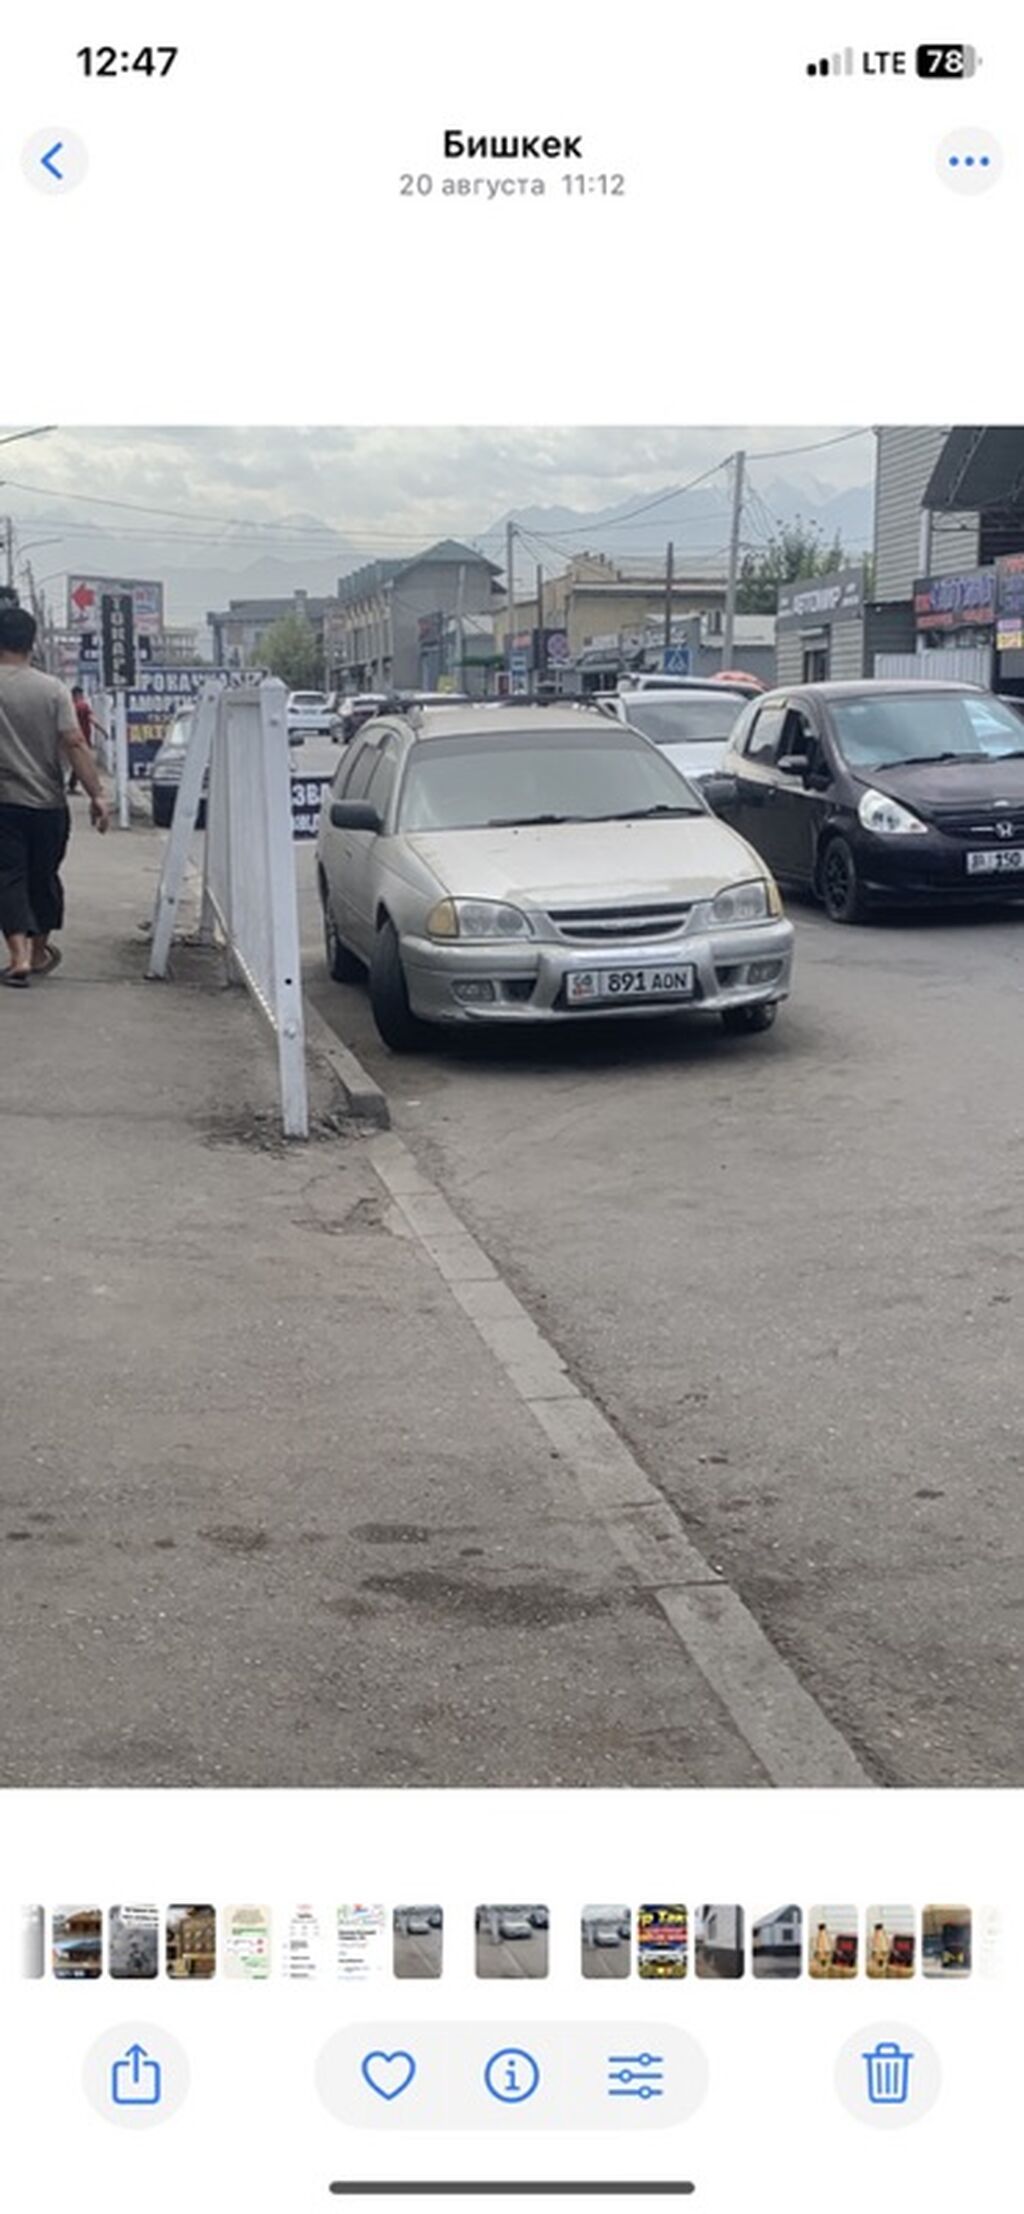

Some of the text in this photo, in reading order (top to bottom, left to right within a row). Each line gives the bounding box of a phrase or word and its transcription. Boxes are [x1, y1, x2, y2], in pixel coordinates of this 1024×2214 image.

[76, 47, 178, 78] 12:47
[862, 51, 906, 74] LTE
[927, 50, 966, 75] 78
[443, 129, 583, 160] Бишкек
[399, 173, 625, 200] 20 августа 11:12
[110, 597, 127, 684] ТОКАРЬ
[608, 971, 646, 991] 891
